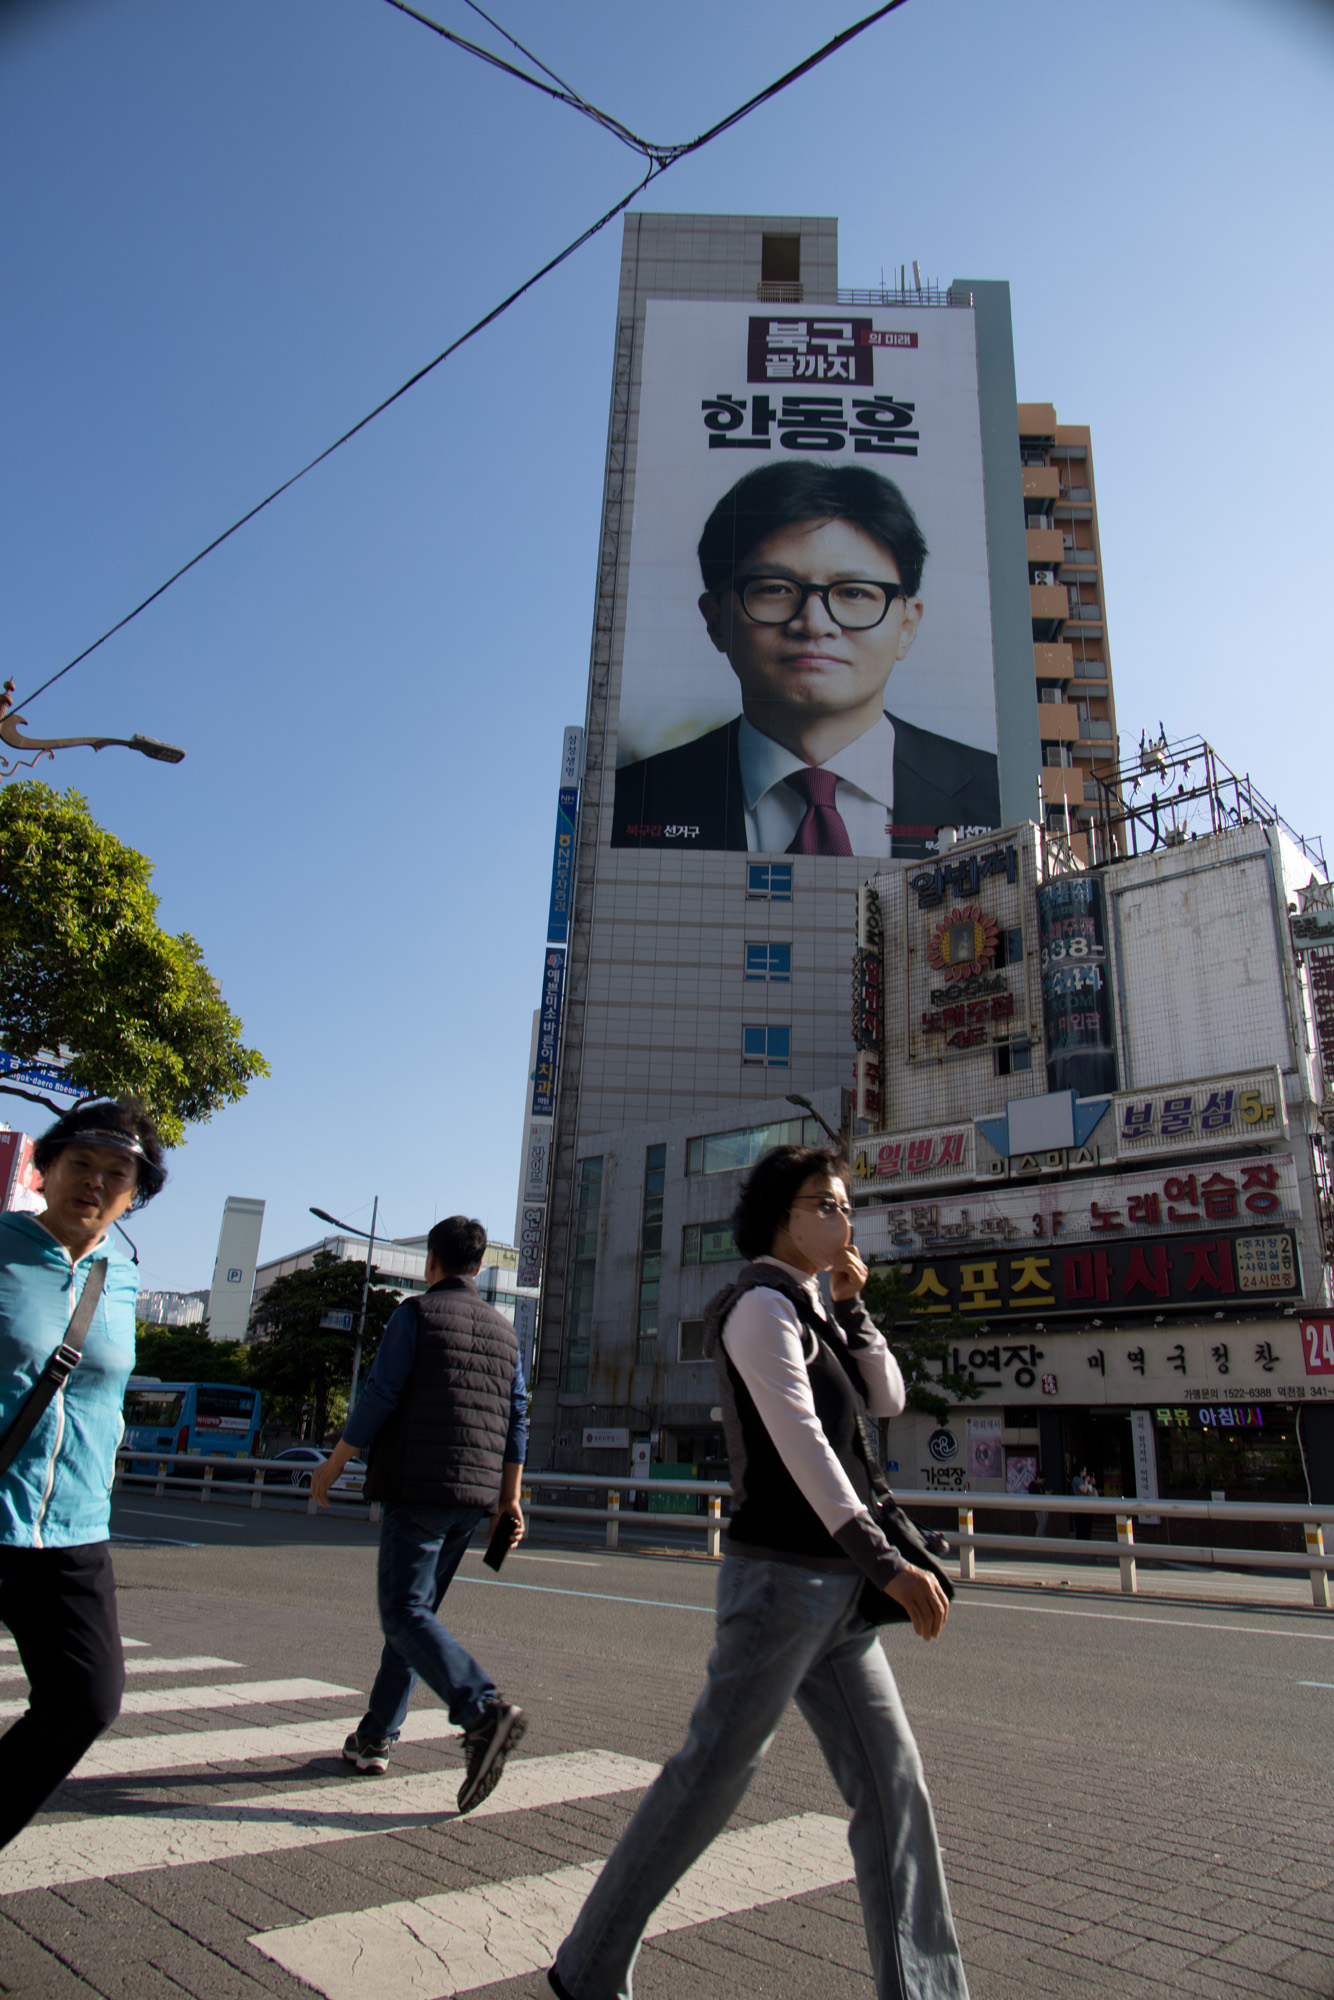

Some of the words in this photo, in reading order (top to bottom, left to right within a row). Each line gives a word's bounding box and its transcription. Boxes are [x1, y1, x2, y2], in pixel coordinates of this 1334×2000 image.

[766, 321, 855, 354] 북구
[869, 332, 882, 345] 의
[885, 332, 912, 346] 미래
[765, 353, 856, 381] 끝까지
[701, 394, 920, 456] 한동훈
[565, 735, 577, 777] 삼성생명
[560, 794, 575, 803] NH
[663, 824, 700, 839] 선거구
[911, 846, 1017, 909] 일번지
[930, 974, 1007, 1004] ROOM
[922, 993, 1014, 1034] 노래주점
[947, 1026, 988, 1048] 4F
[1121, 1089, 1234, 1139] 보물섬
[1239, 1089, 1276, 1124] 5F
[853, 1150, 876, 1179] 4F
[876, 1133, 965, 1177] 일번지
[989, 1145, 1100, 1179] 미스미시
[1090, 1163, 1281, 1232] 노래연습장
[522, 1208, 543, 1265] 연예인
[1242, 1237, 1278, 1250] 주차장
[1280, 1237, 1293, 1270] 2층
[1244, 1249, 1279, 1261] 수면실
[925, 1344, 1045, 1388] 가연장
[1184, 1387, 1219, 1400] 가맹문의
[1223, 1387, 1273, 1399] 1522-6388
[1310, 1386, 1334, 1397] 341-
[1156, 1407, 1191, 1428] 무휴
[1198, 1405, 1264, 1427] 아침8시
[920, 1466, 966, 1486] 가연장
